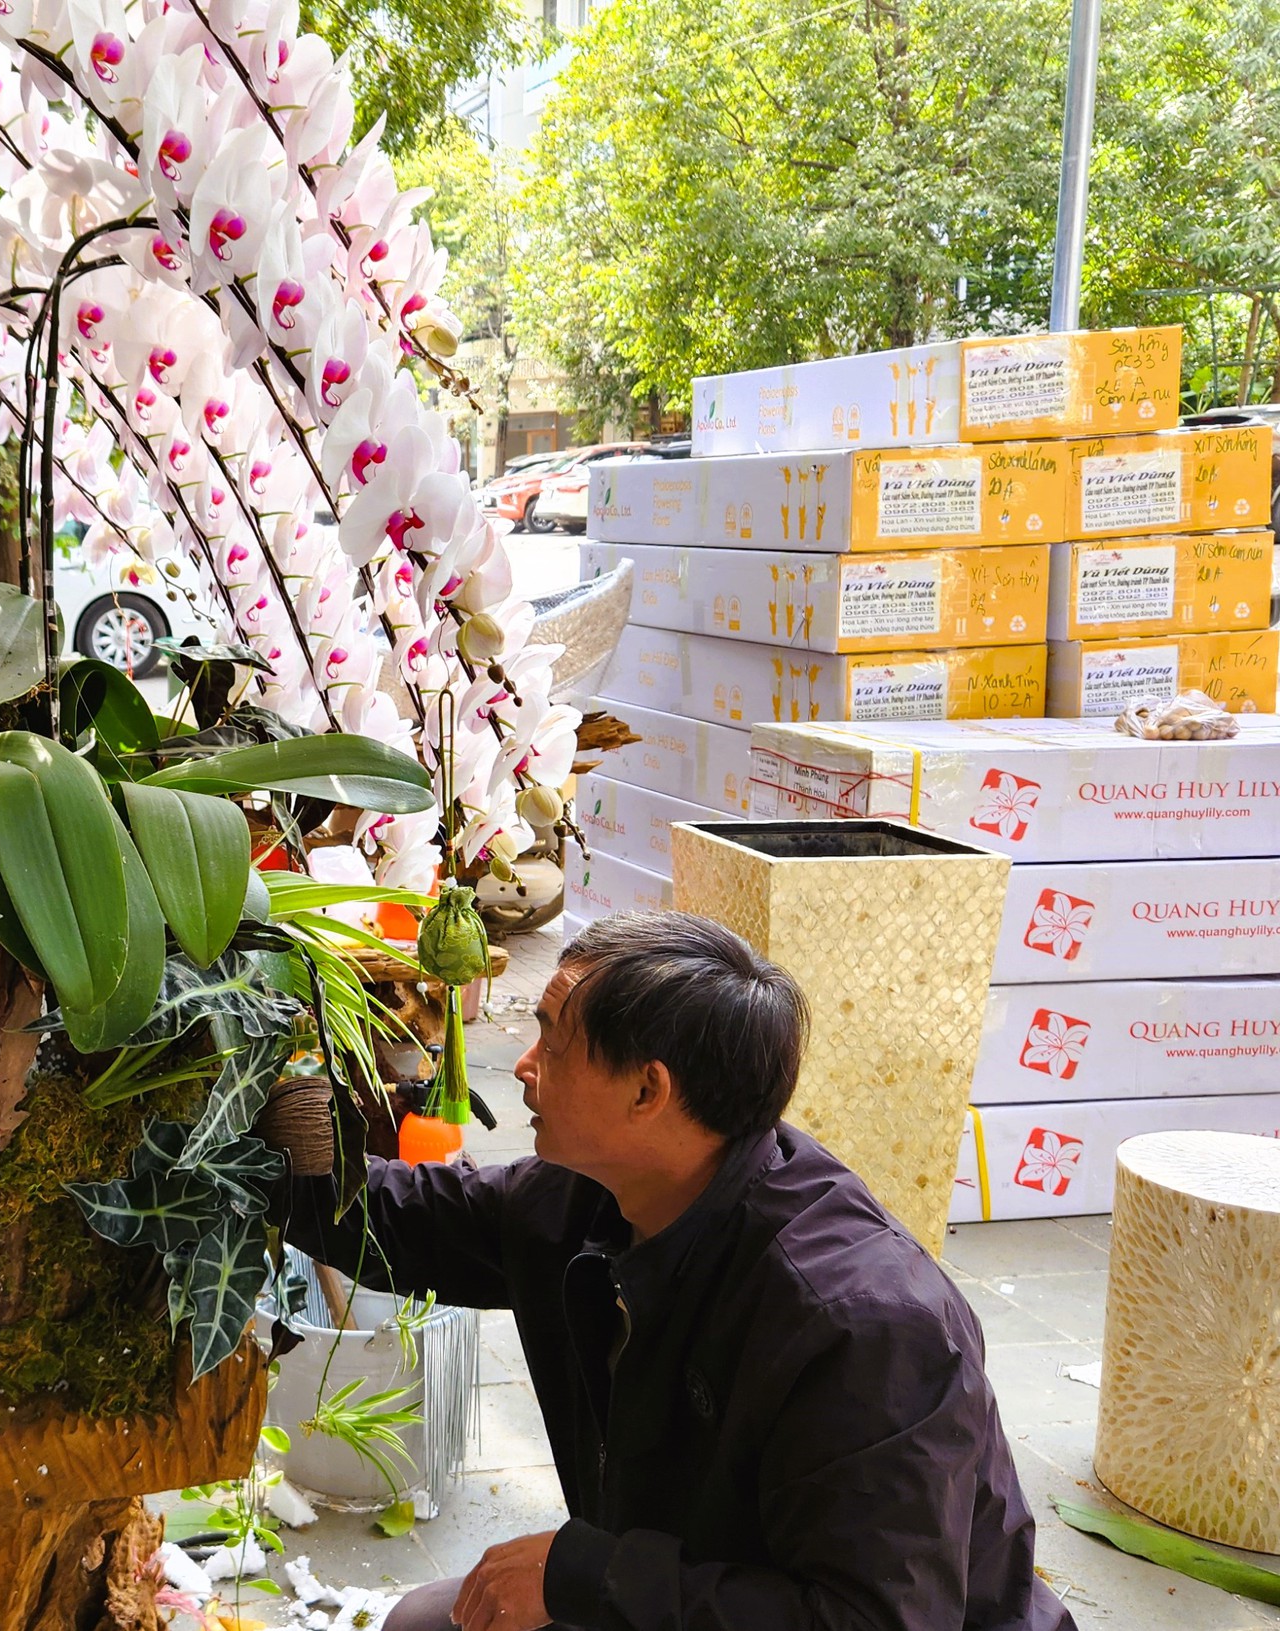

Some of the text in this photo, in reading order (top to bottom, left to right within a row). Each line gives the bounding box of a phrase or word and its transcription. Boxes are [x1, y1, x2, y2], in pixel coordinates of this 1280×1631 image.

[1079, 783, 1167, 804] QUANG
[1177, 782, 1230, 799] HUY
[1114, 808, 1250, 820] www.quanghuylily.com
[1132, 900, 1280, 923] QUANG HUY
[1130, 1019, 1280, 1042] QUANG HUY
